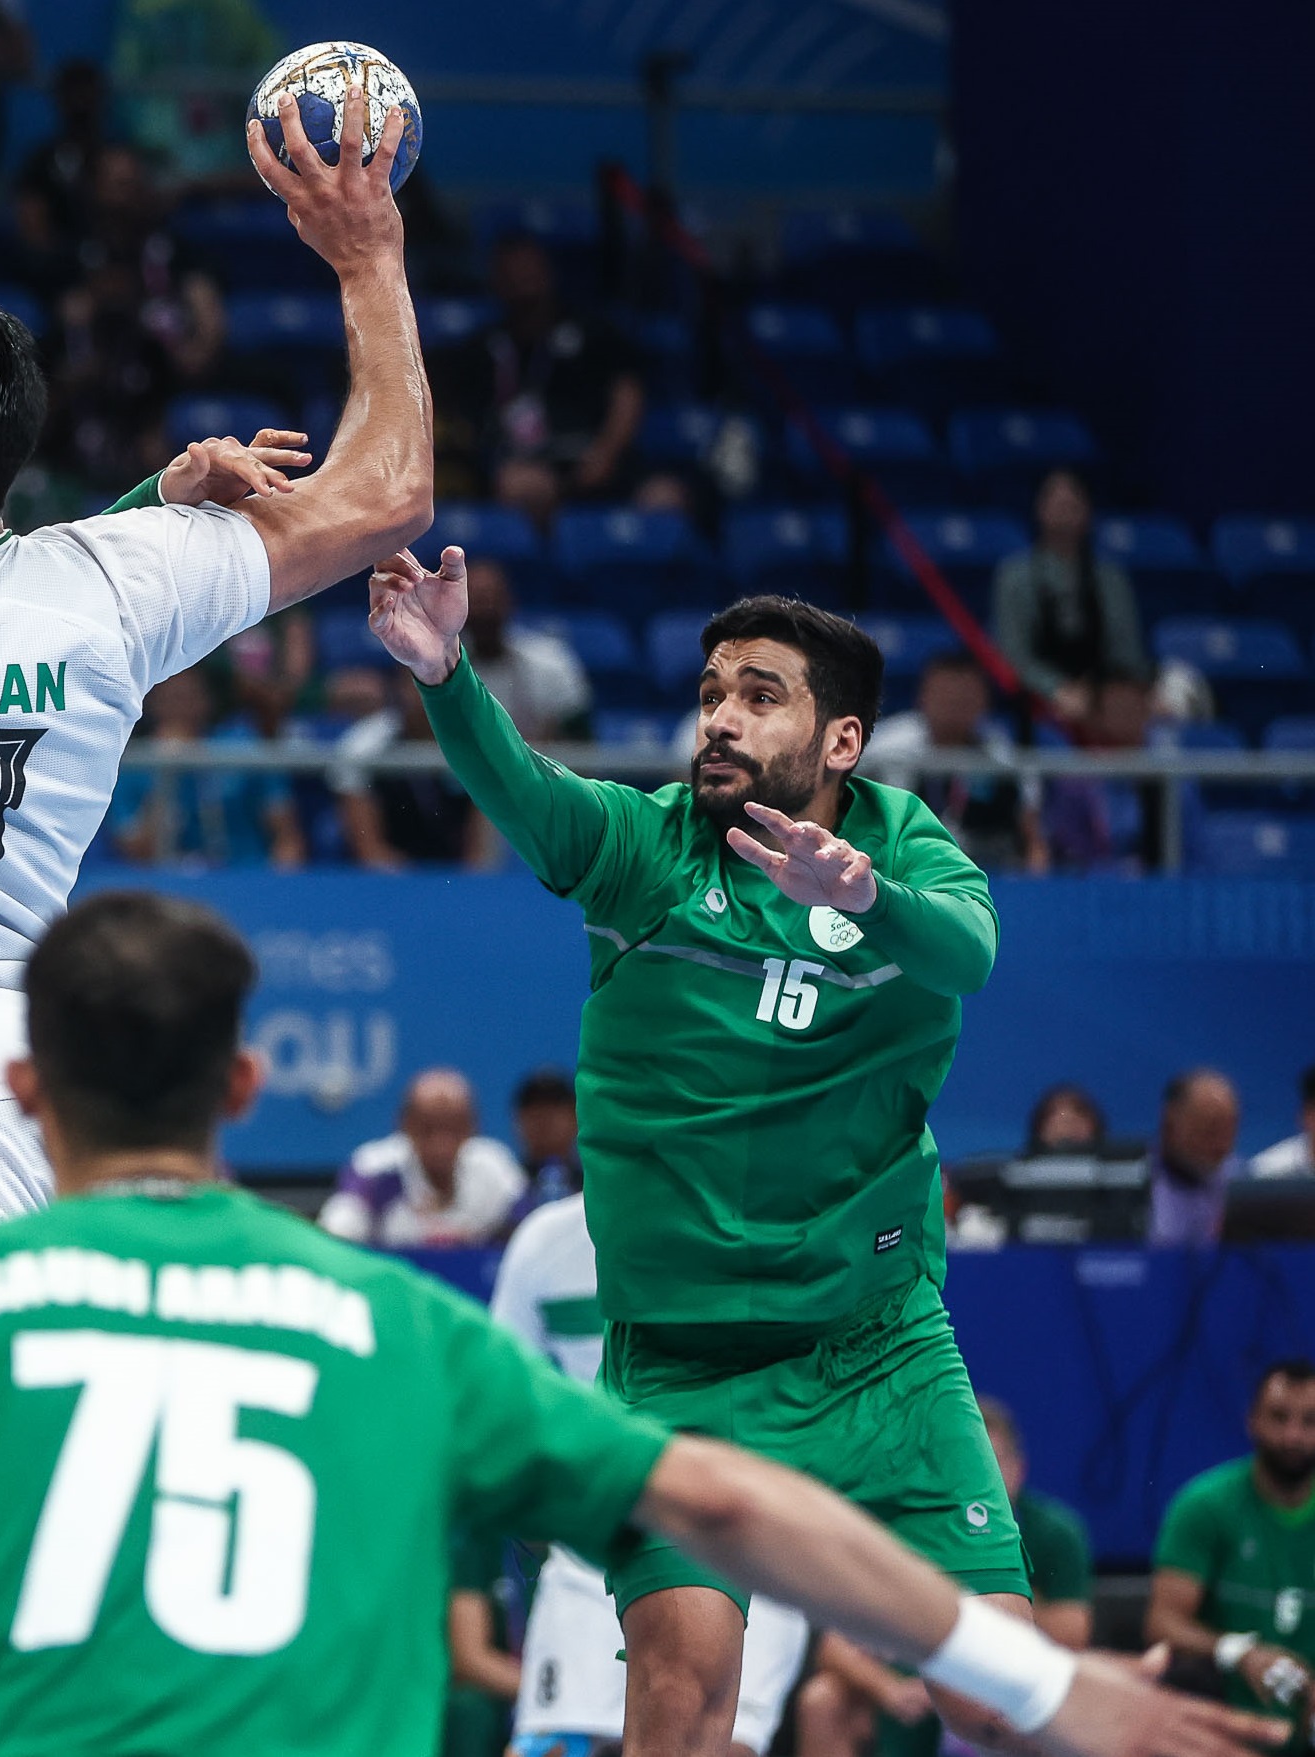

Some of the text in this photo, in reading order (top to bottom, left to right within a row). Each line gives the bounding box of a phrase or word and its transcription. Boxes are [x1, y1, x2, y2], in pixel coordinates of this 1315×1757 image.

[755, 957, 826, 1031] 15
[154, 1262, 377, 1358] ARABIA
[10, 1327, 320, 1657] 75
